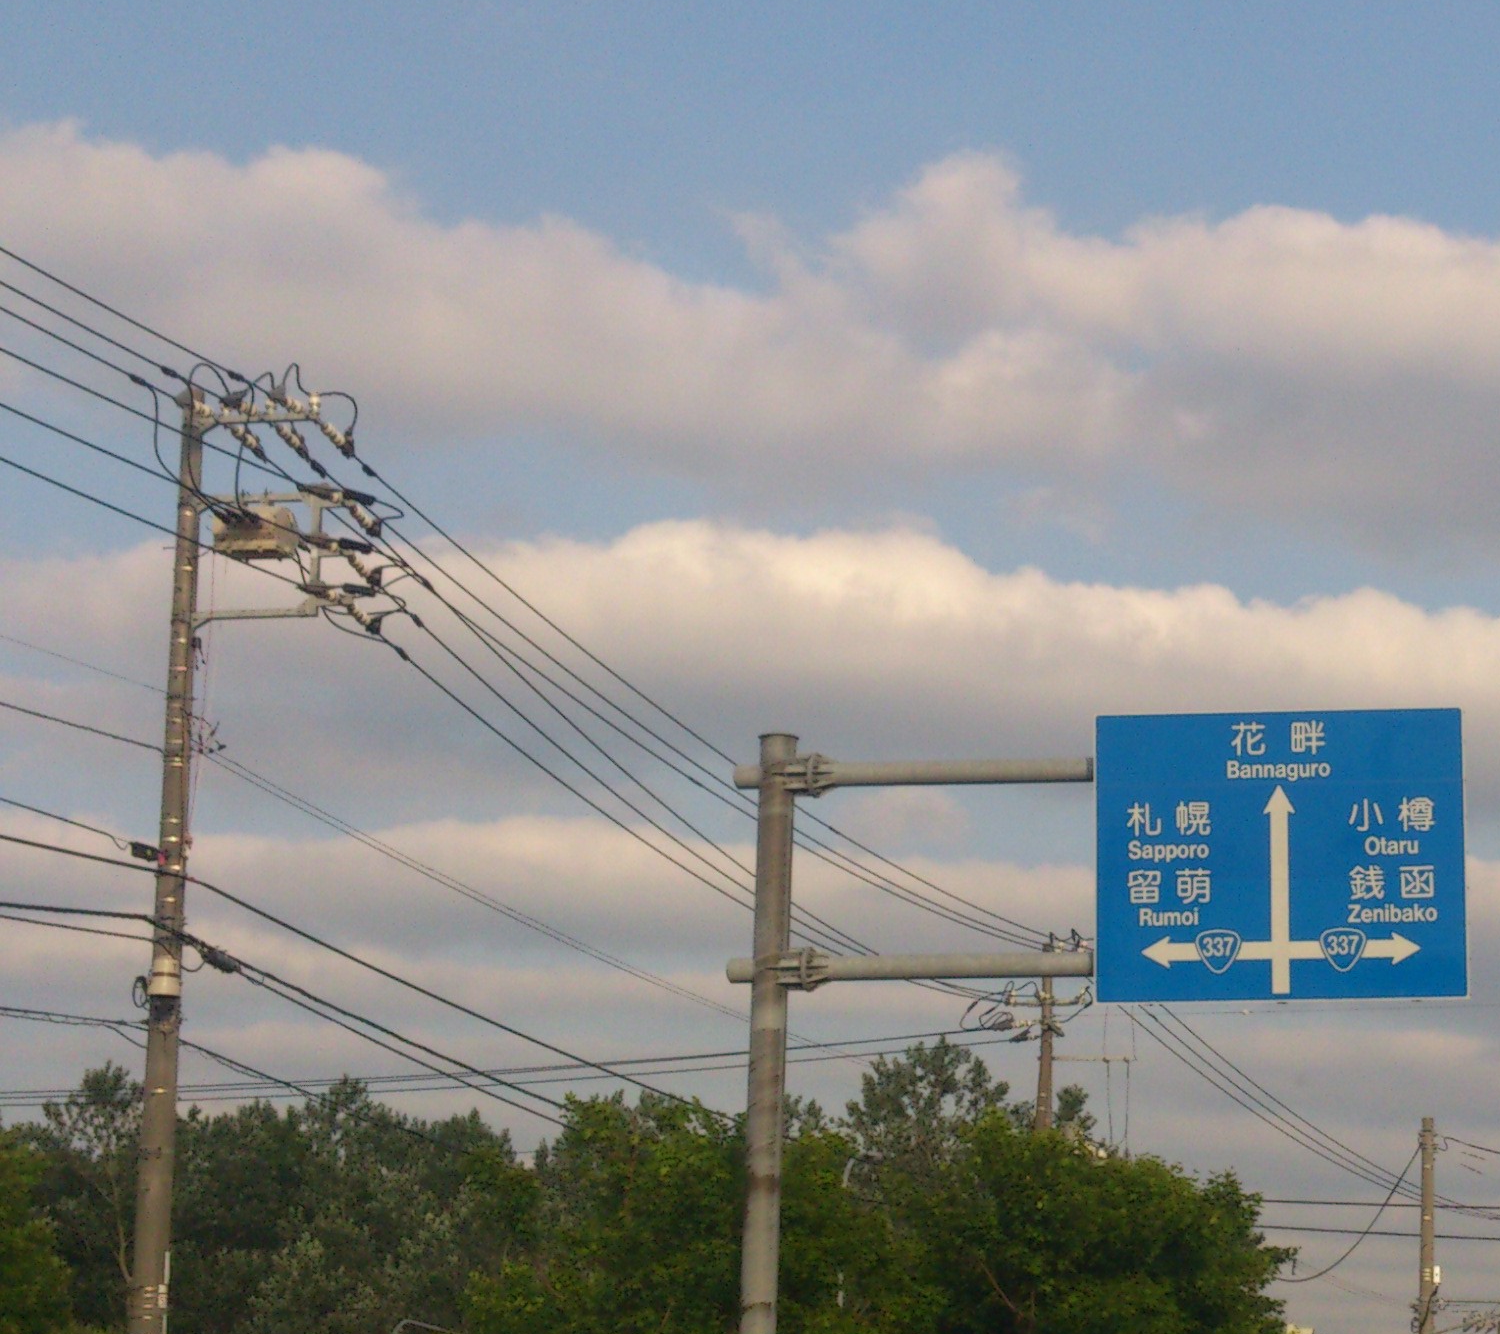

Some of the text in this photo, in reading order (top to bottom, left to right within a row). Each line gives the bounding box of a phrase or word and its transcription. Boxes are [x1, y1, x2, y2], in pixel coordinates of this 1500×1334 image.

[1226, 760, 1331, 782] Bannaguro
[1126, 801, 1211, 837] 札幌
[1348, 796, 1436, 832] 小樽
[1127, 840, 1209, 863] Sapporo
[1364, 836, 1419, 856] Otaru
[1126, 868, 1211, 905] 留萌
[1138, 907, 1200, 927] Rumoi
[1347, 903, 1438, 924] Zenibako
[1201, 936, 1235, 958] 337
[1326, 934, 1360, 955] 337
